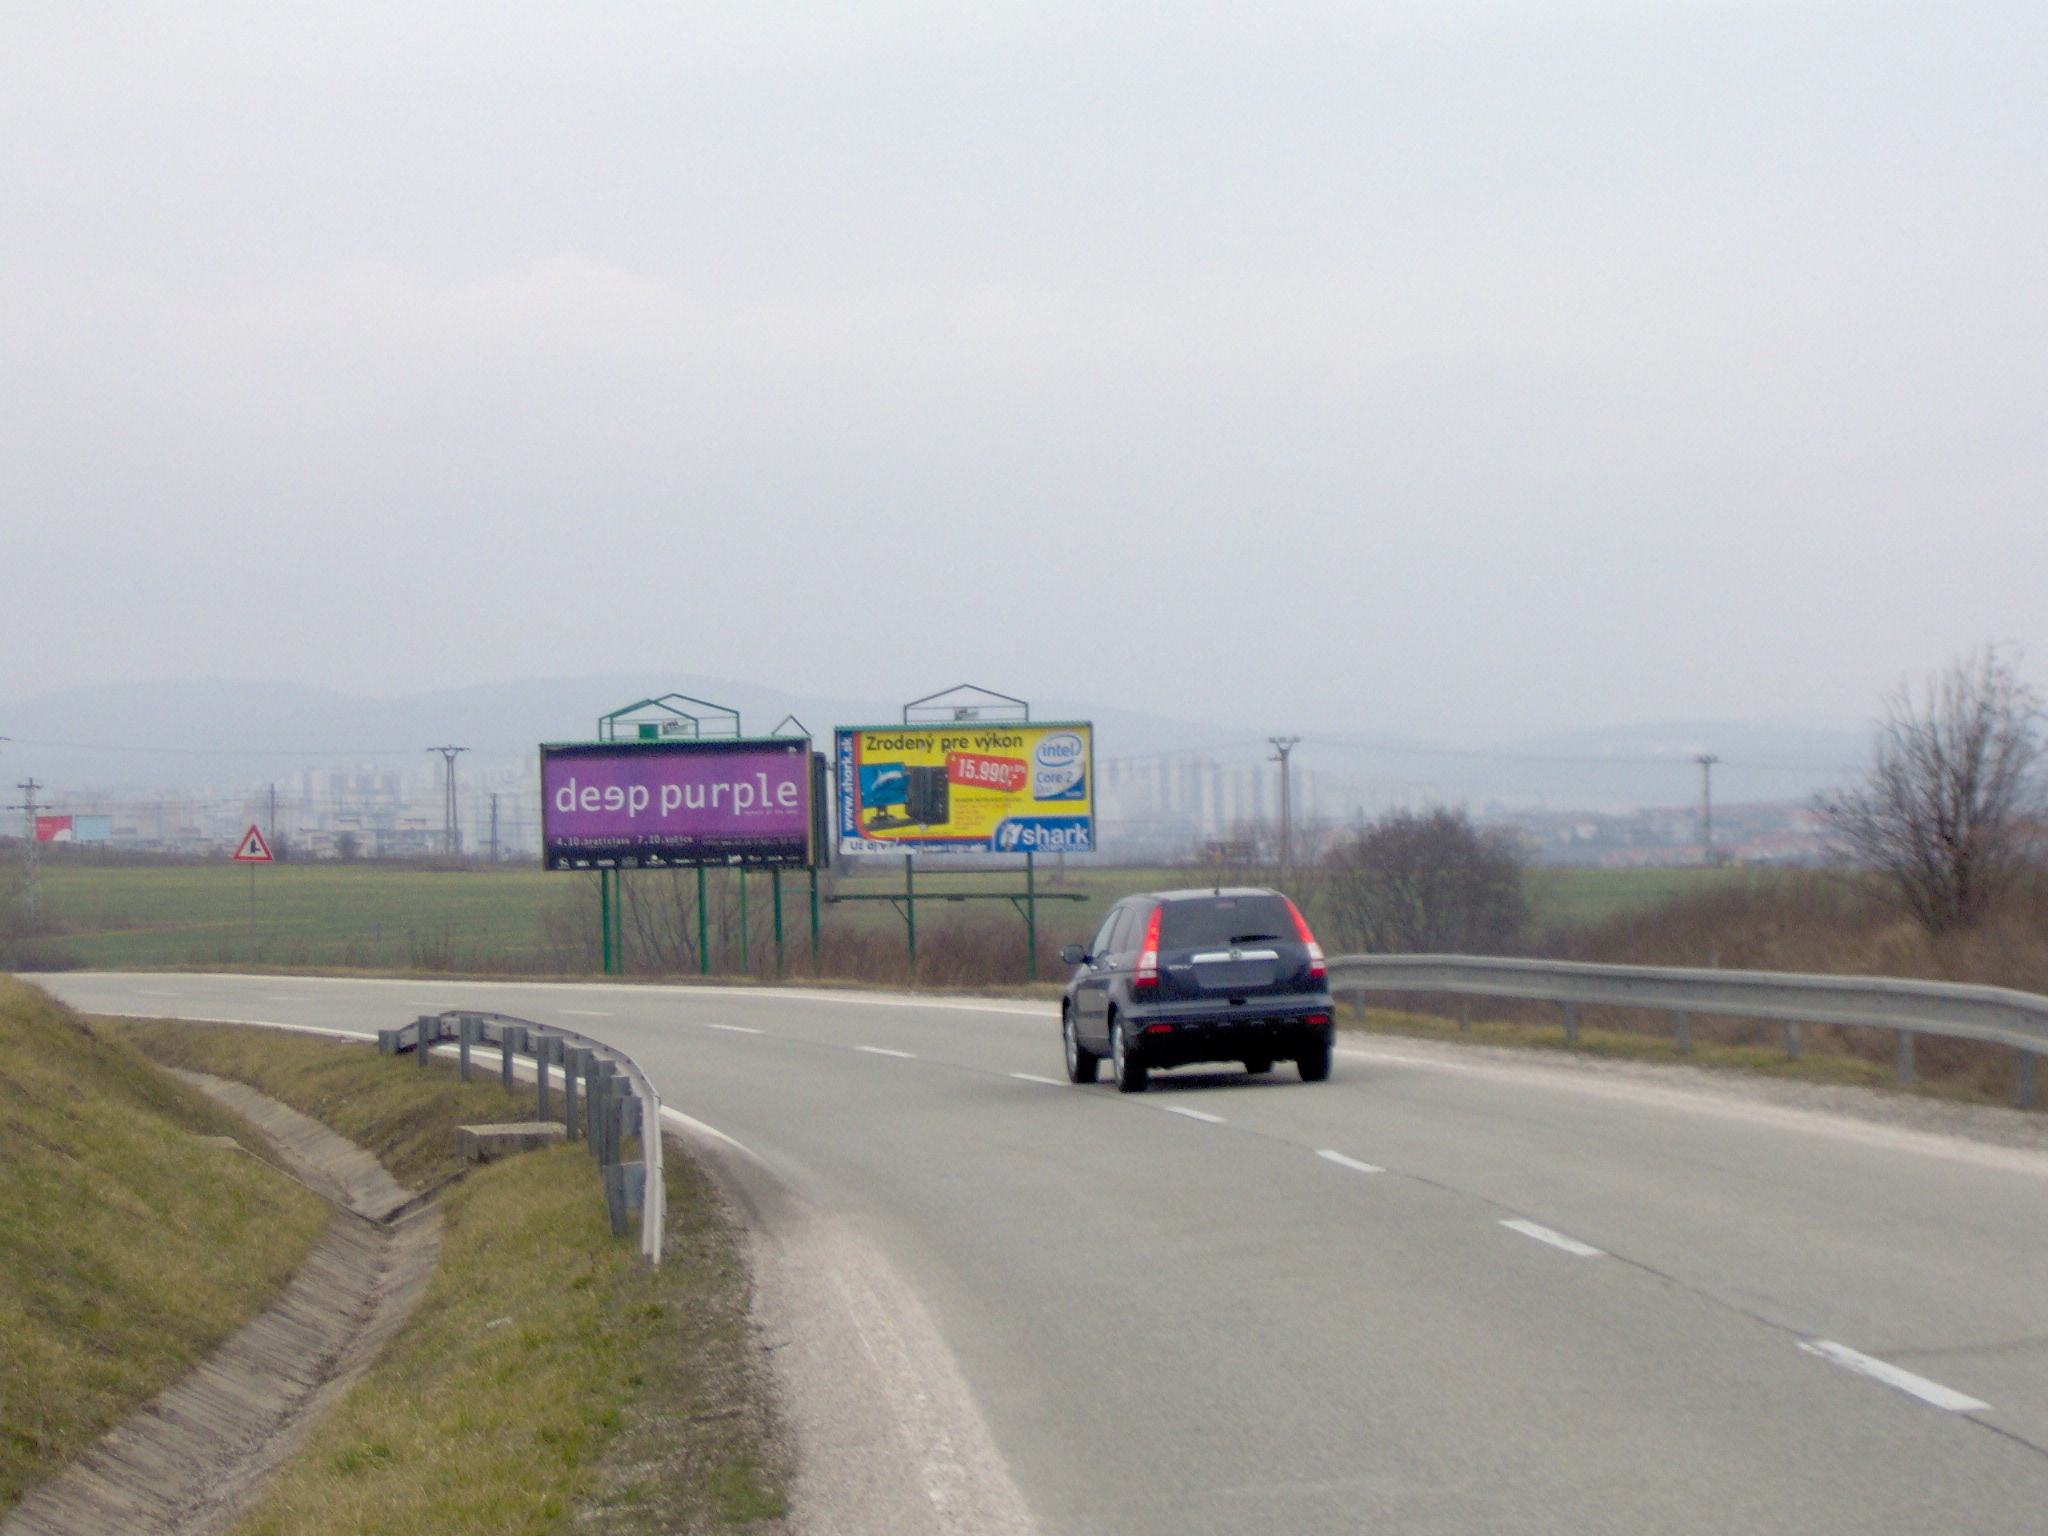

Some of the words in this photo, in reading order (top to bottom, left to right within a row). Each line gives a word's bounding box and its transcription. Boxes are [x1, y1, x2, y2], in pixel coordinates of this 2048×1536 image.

[866, 735, 934, 753] Zrodený
[942, 738, 968, 753] pre
[977, 733, 1023, 750] výkon
[1042, 742, 1074, 757] intel
[841, 737, 854, 831] www.shark.sk
[1036, 771, 1063, 784] Core
[1067, 770, 1075, 783] 2
[556, 778, 649, 818] deep
[662, 773, 798, 817] purple
[1022, 823, 1089, 846] shark
